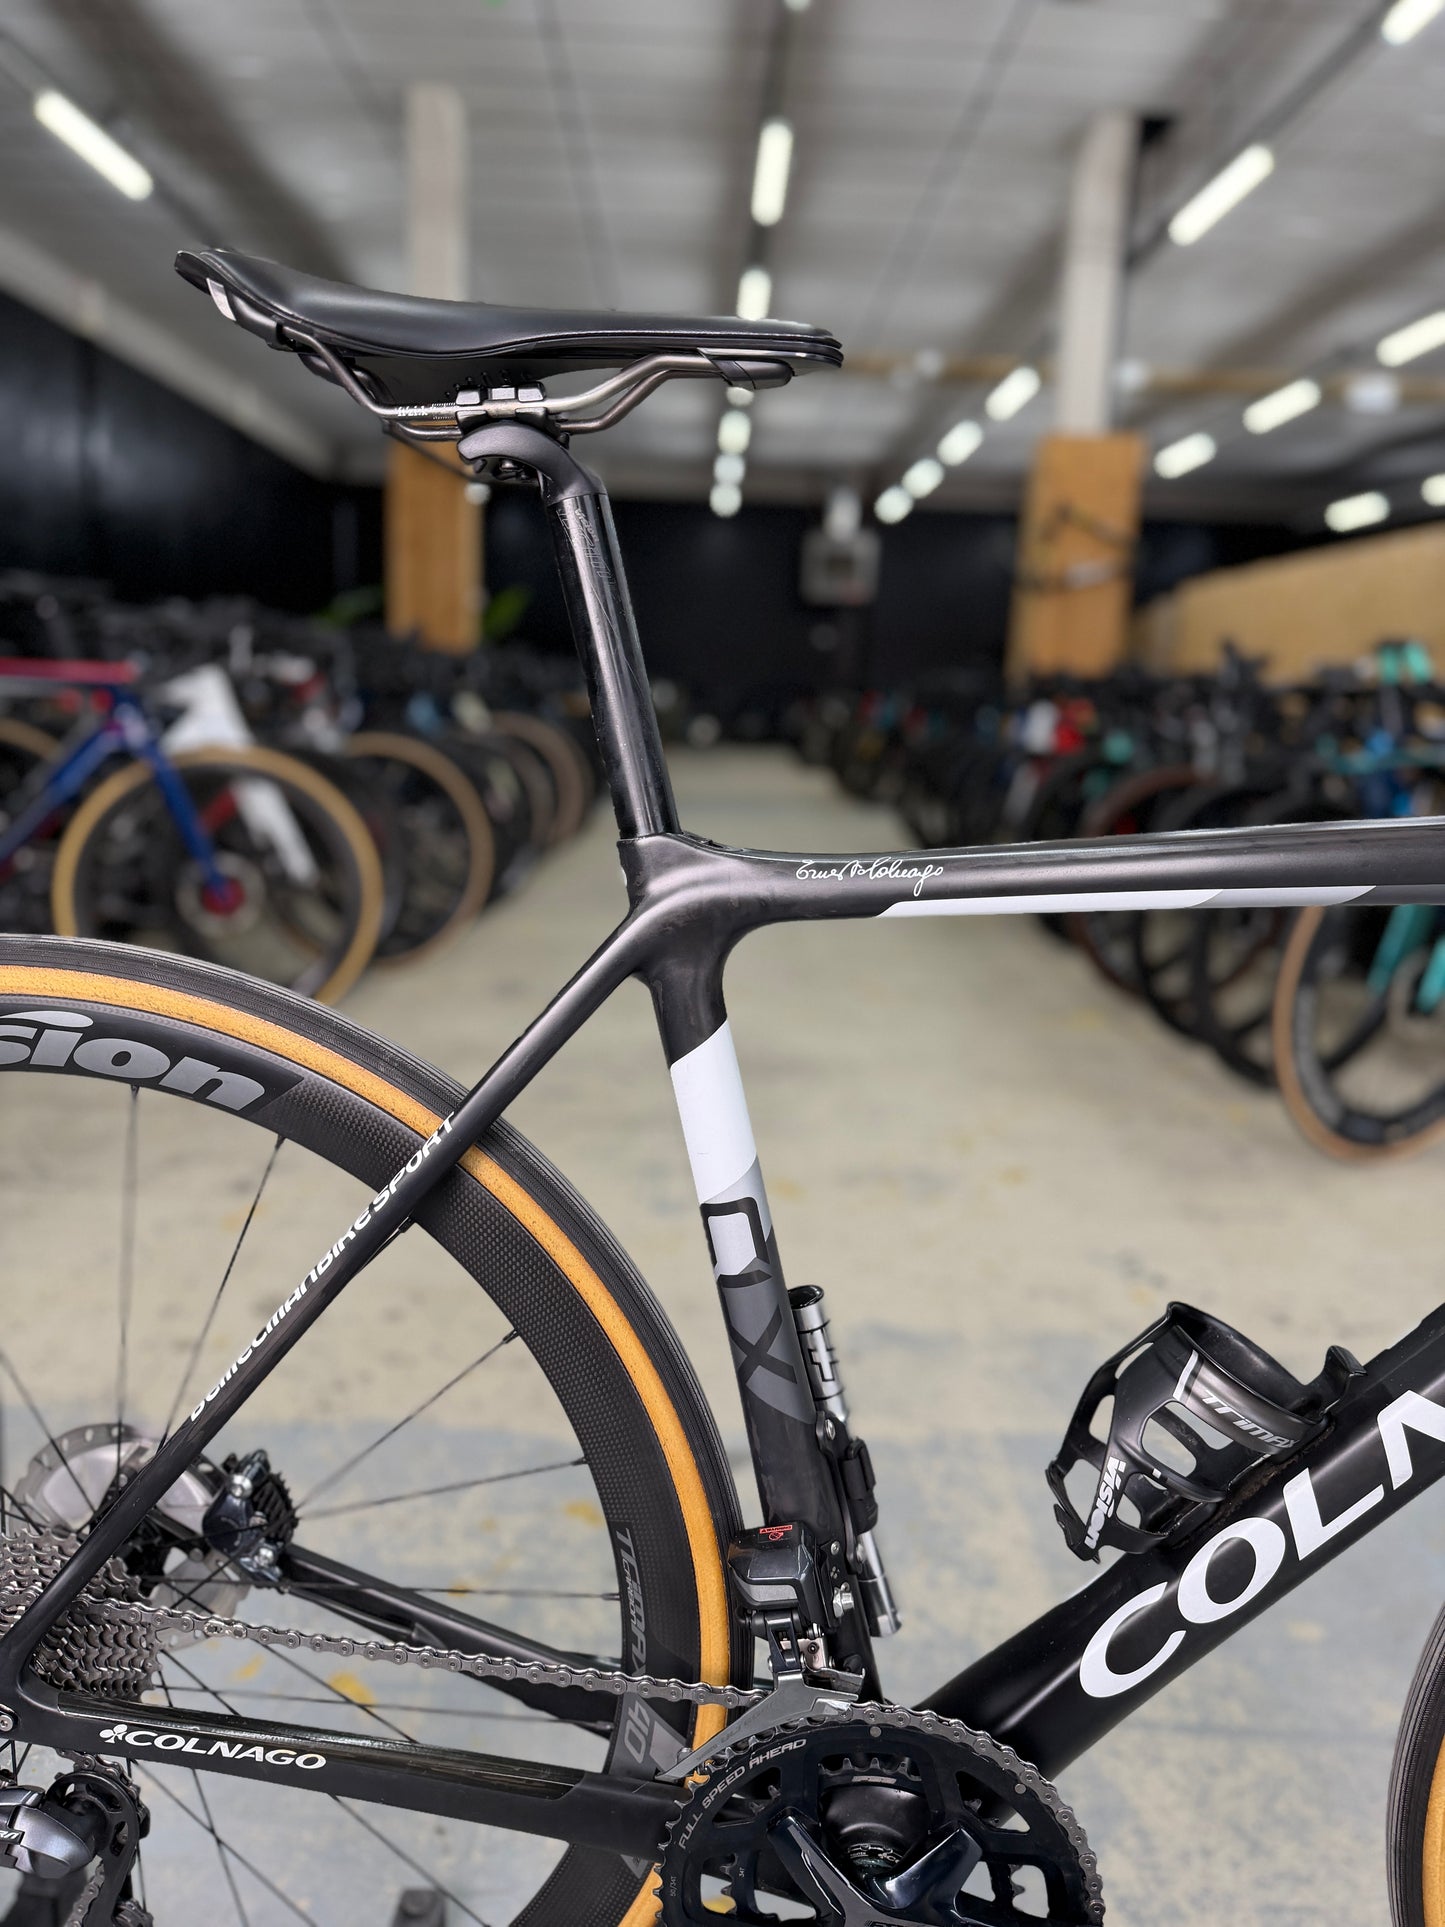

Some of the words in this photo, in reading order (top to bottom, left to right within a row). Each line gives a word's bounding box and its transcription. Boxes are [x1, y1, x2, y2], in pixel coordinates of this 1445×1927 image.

[125, 1730, 327, 1770] COLNAGO
[678, 1812, 703, 1849] FULL
[702, 1765, 746, 1809] SPEED
[748, 1739, 807, 1770] AHEAD
